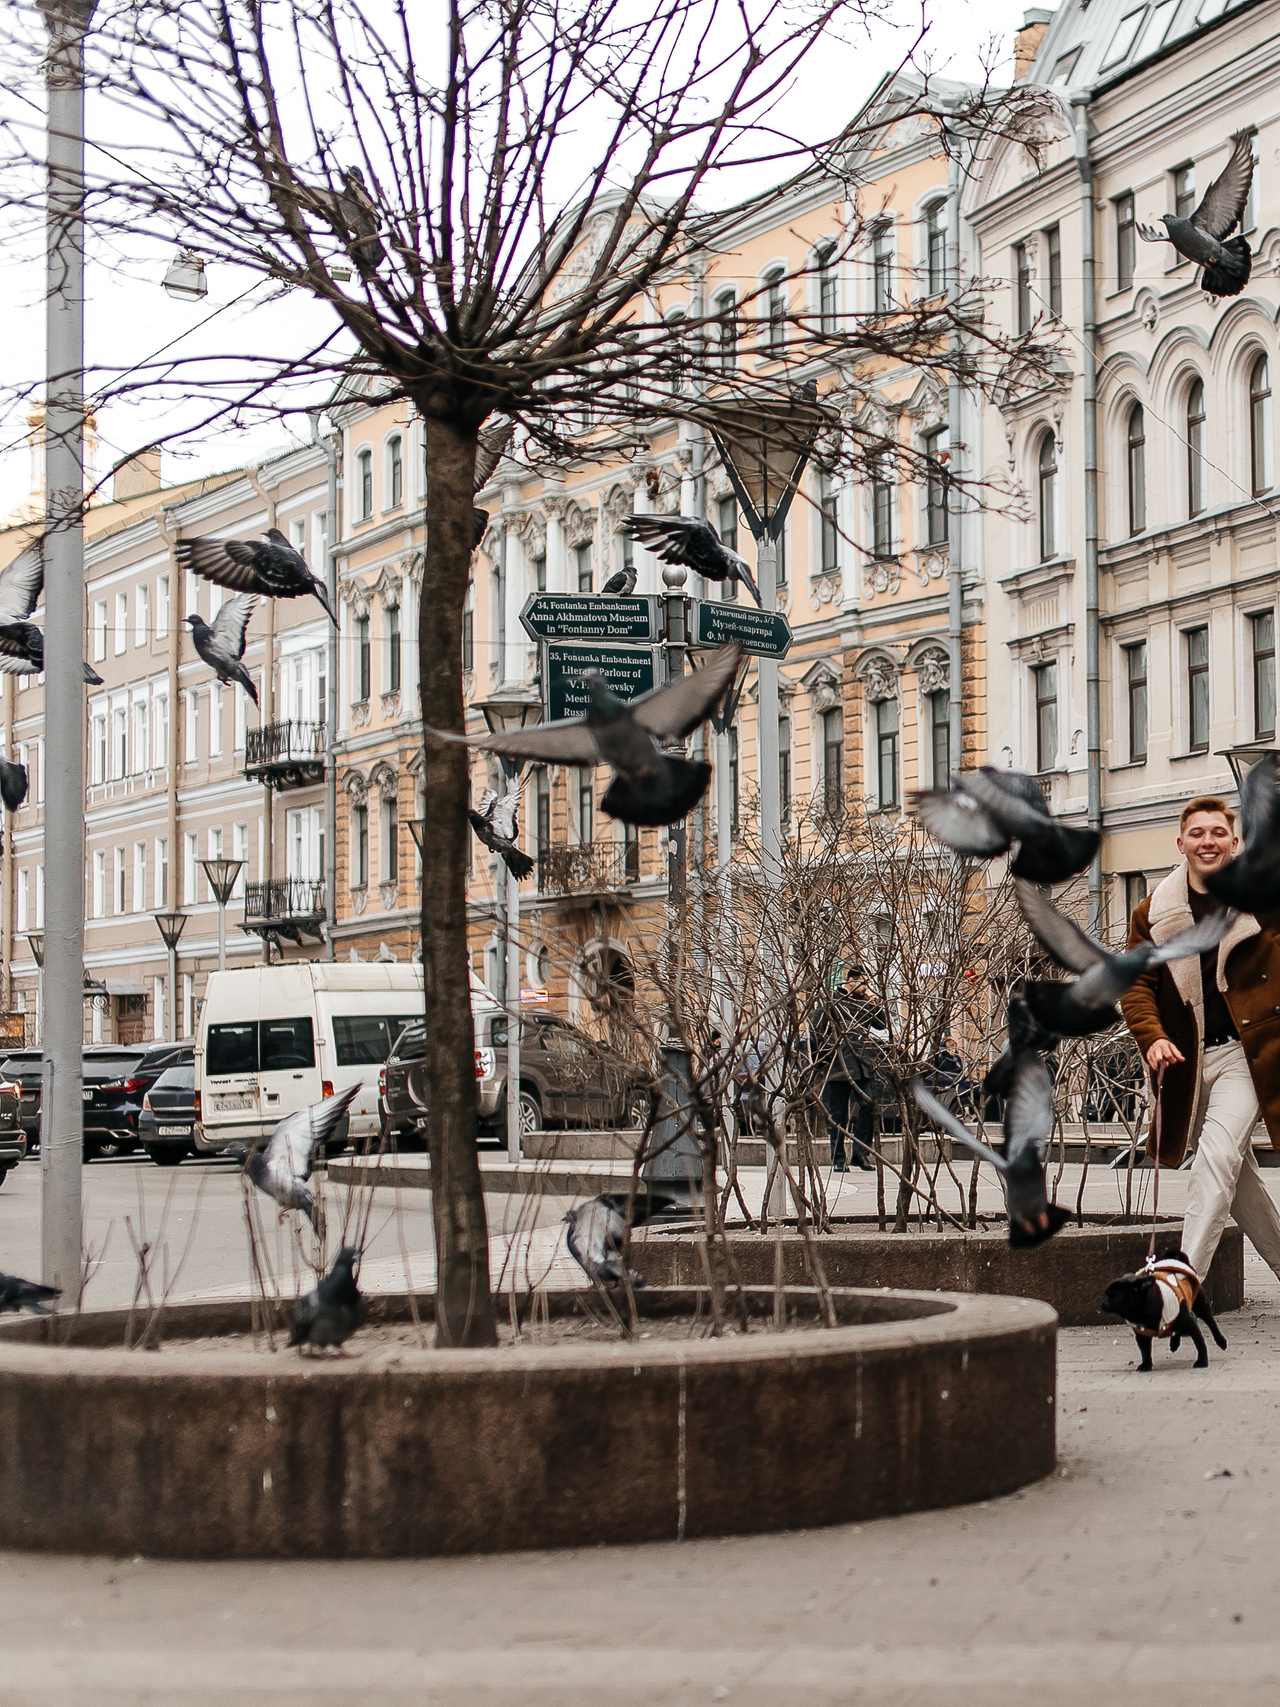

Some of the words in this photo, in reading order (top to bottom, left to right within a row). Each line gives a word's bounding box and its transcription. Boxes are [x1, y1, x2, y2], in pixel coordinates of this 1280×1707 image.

[537, 601, 549, 610] 34,
[550, 601, 587, 610] Fontanka
[588, 602, 640, 611] Embankment
[530, 612, 554, 621] Anna
[556, 612, 608, 622] Akhmatova
[609, 613, 648, 623] Museum
[710, 607, 747, 619] Кузнечный
[763, 616, 774, 624] 5/2
[546, 624, 556, 633] in
[712, 619, 773, 637] Музей-квартира
[706, 630, 716, 640] Ф.
[549, 652, 561, 661] 35,
[562, 653, 600, 663] Fontanka
[601, 655, 651, 665] Embankment
[599, 668, 631, 678] Parlour
[632, 669, 641, 678] of
[568, 680, 579, 689] V.
[606, 683, 635, 693] oevsky
[565, 694, 592, 703] Meeti
[563, 708, 588, 716] Russi
